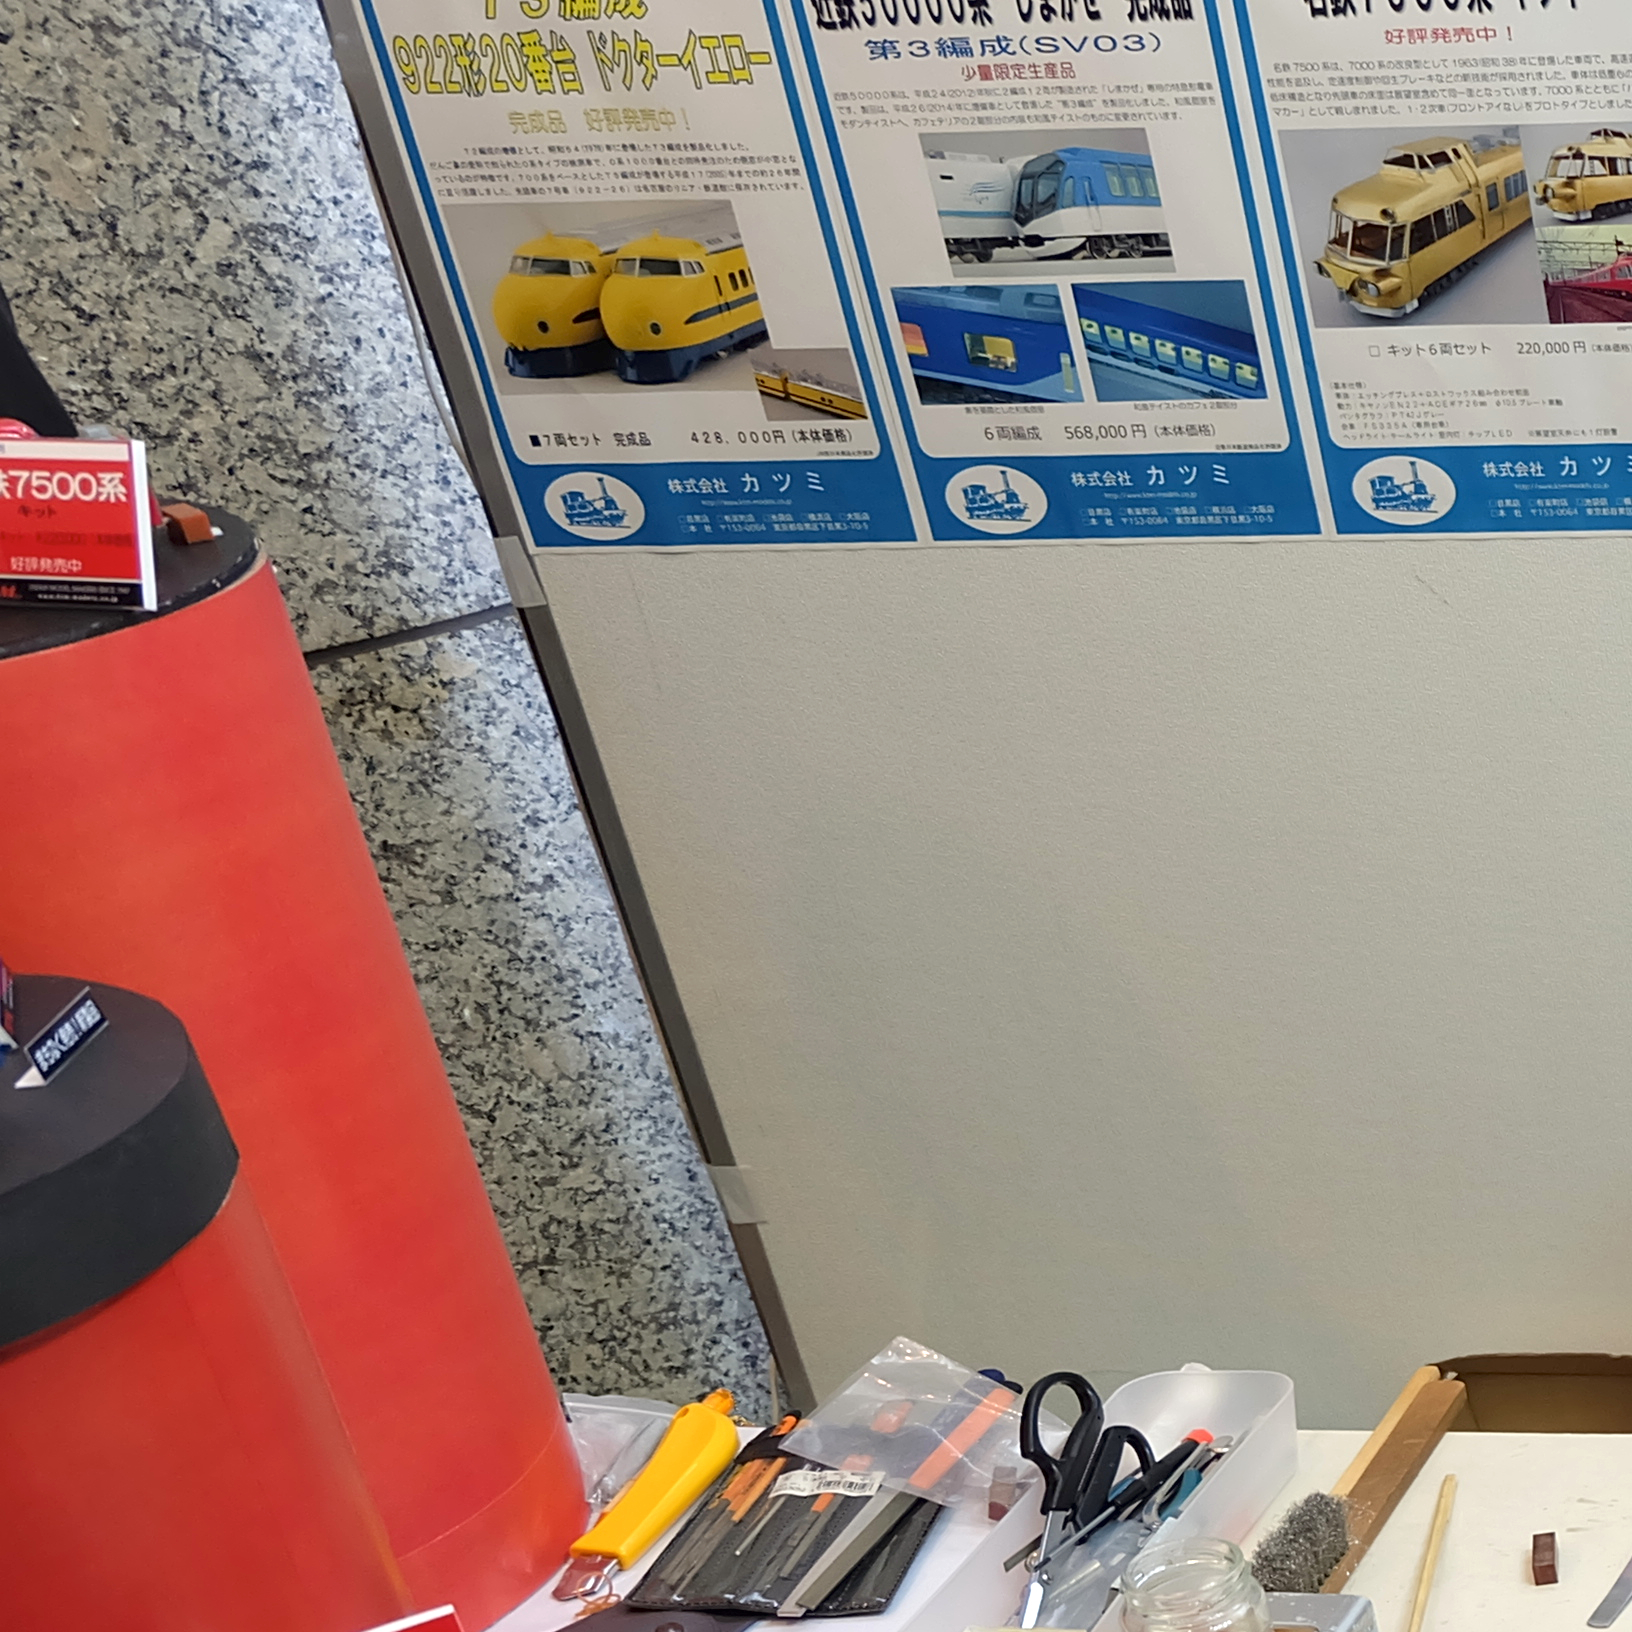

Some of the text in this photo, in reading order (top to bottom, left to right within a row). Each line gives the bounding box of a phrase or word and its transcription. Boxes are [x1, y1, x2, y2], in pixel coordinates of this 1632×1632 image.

[1384, 26, 1514, 44] 好評発売中！
[864, 32, 1163, 61] 第3編成(SV03)
[393, 29, 772, 97] 922形20番台 ドクターイエロー
[961, 62, 1077, 81] 少量限定生産品
[508, 107, 691, 134] 完成品 好評発売中！
[613, 434, 652, 447] 完成品
[1070, 464, 1230, 487] 株式会社 カツミ
[1482, 462, 1546, 478] 株式会社
[667, 472, 825, 494] 株式会社 カツミ
